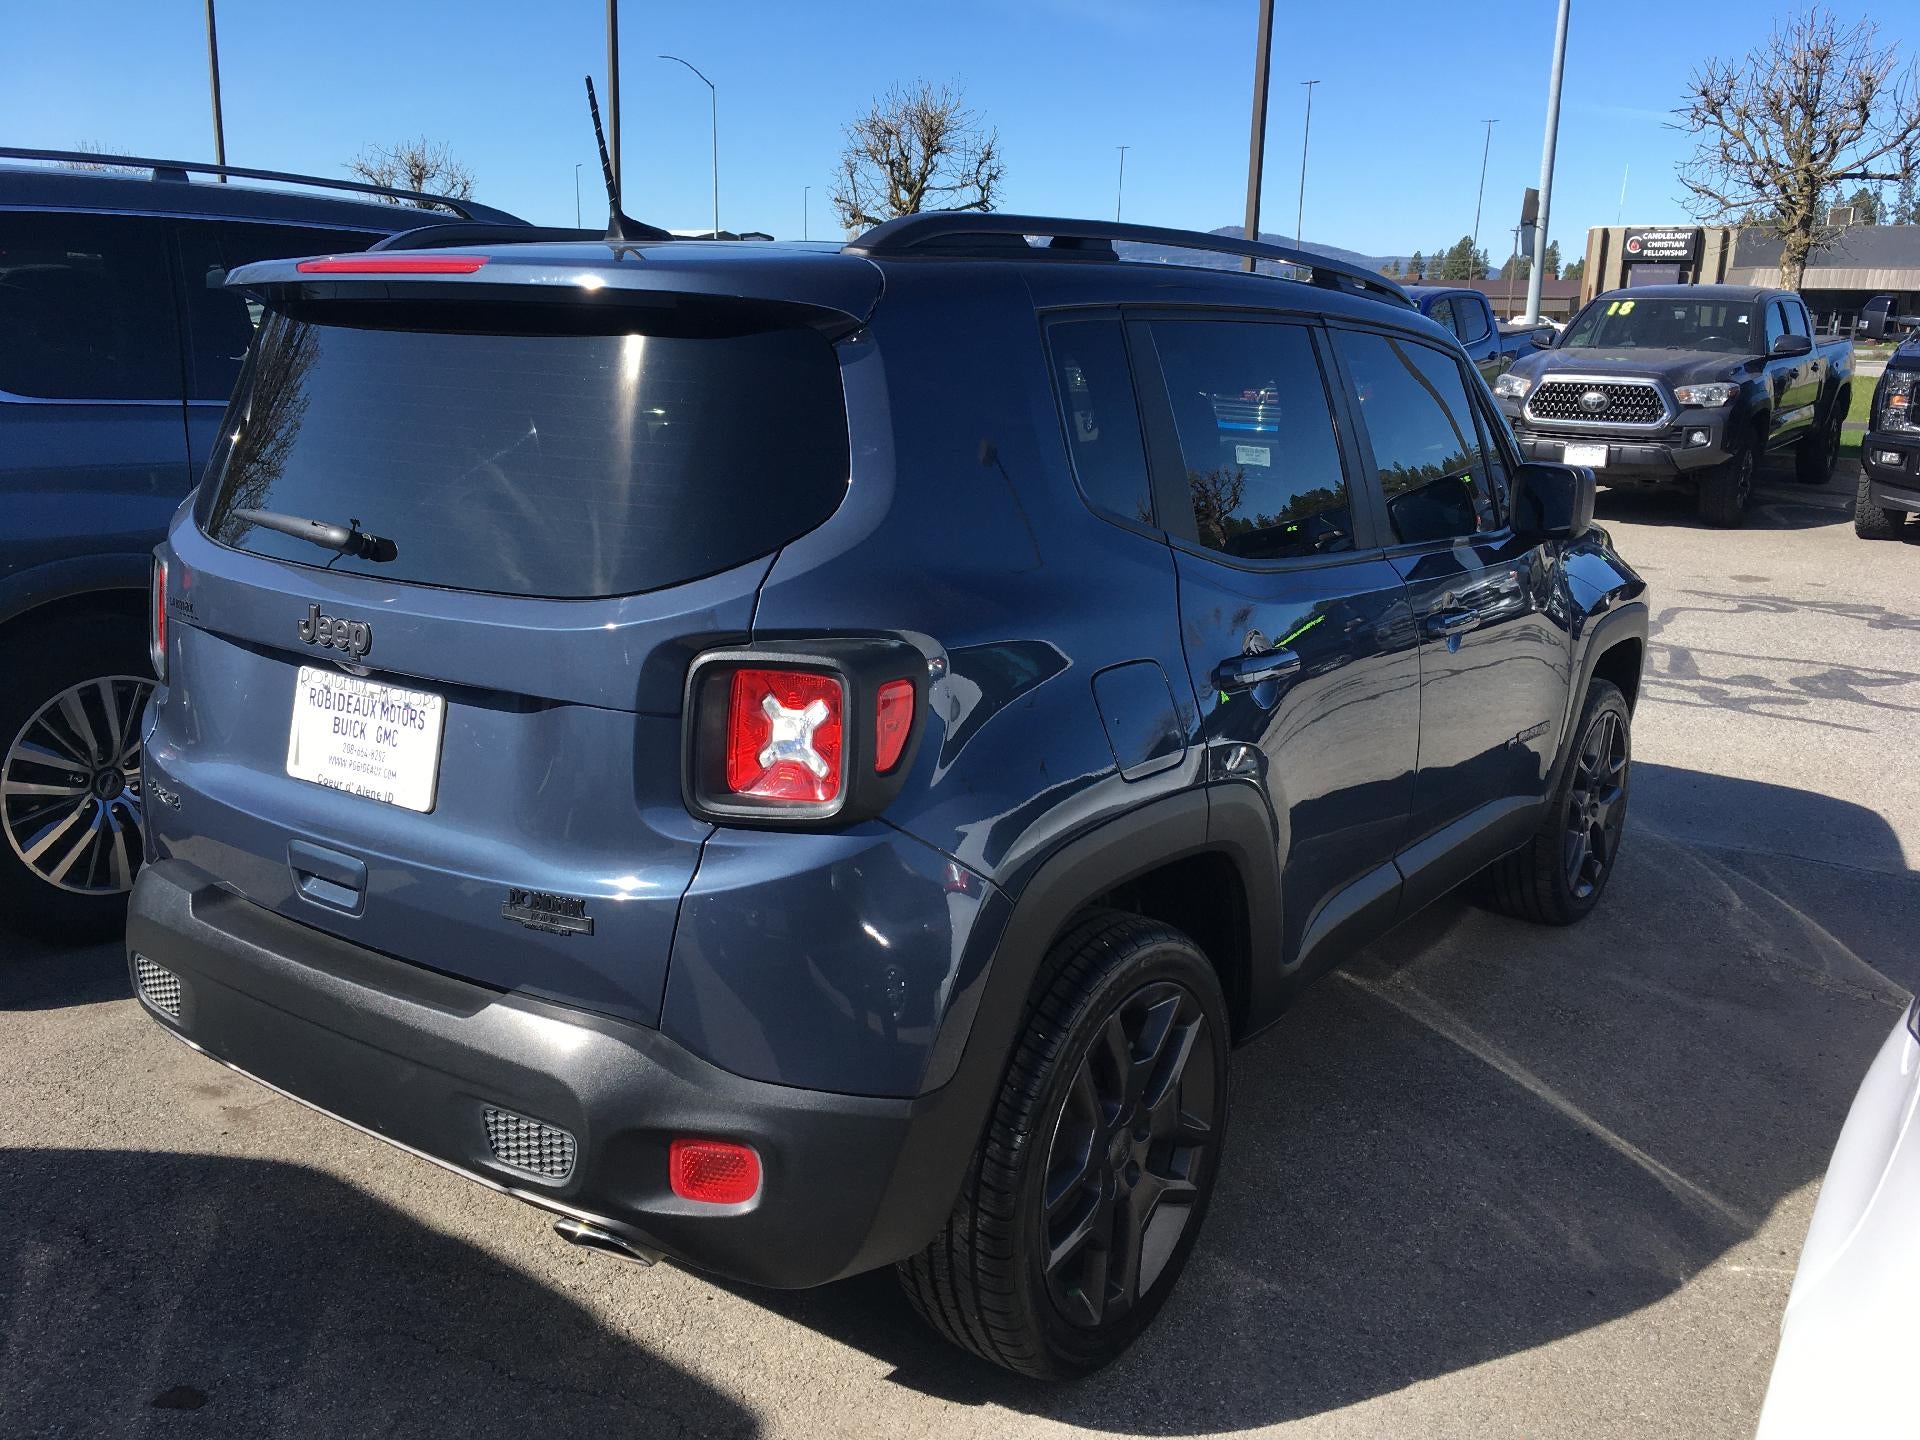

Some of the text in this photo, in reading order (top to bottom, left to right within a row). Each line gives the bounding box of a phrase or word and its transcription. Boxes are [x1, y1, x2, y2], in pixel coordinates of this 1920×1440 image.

[1642, 232, 1692, 240] CANDLELIGHT
[1643, 249, 1688, 257] FELLOWSHIP
[1607, 301, 1635, 316] 18
[298, 603, 372, 662] Jeep
[309, 687, 426, 731] ROBIDEAUX MOTORS
[332, 716, 399, 747] BUICK GMC
[317, 773, 342, 790] Coeur
[385, 791, 394, 803] ID
